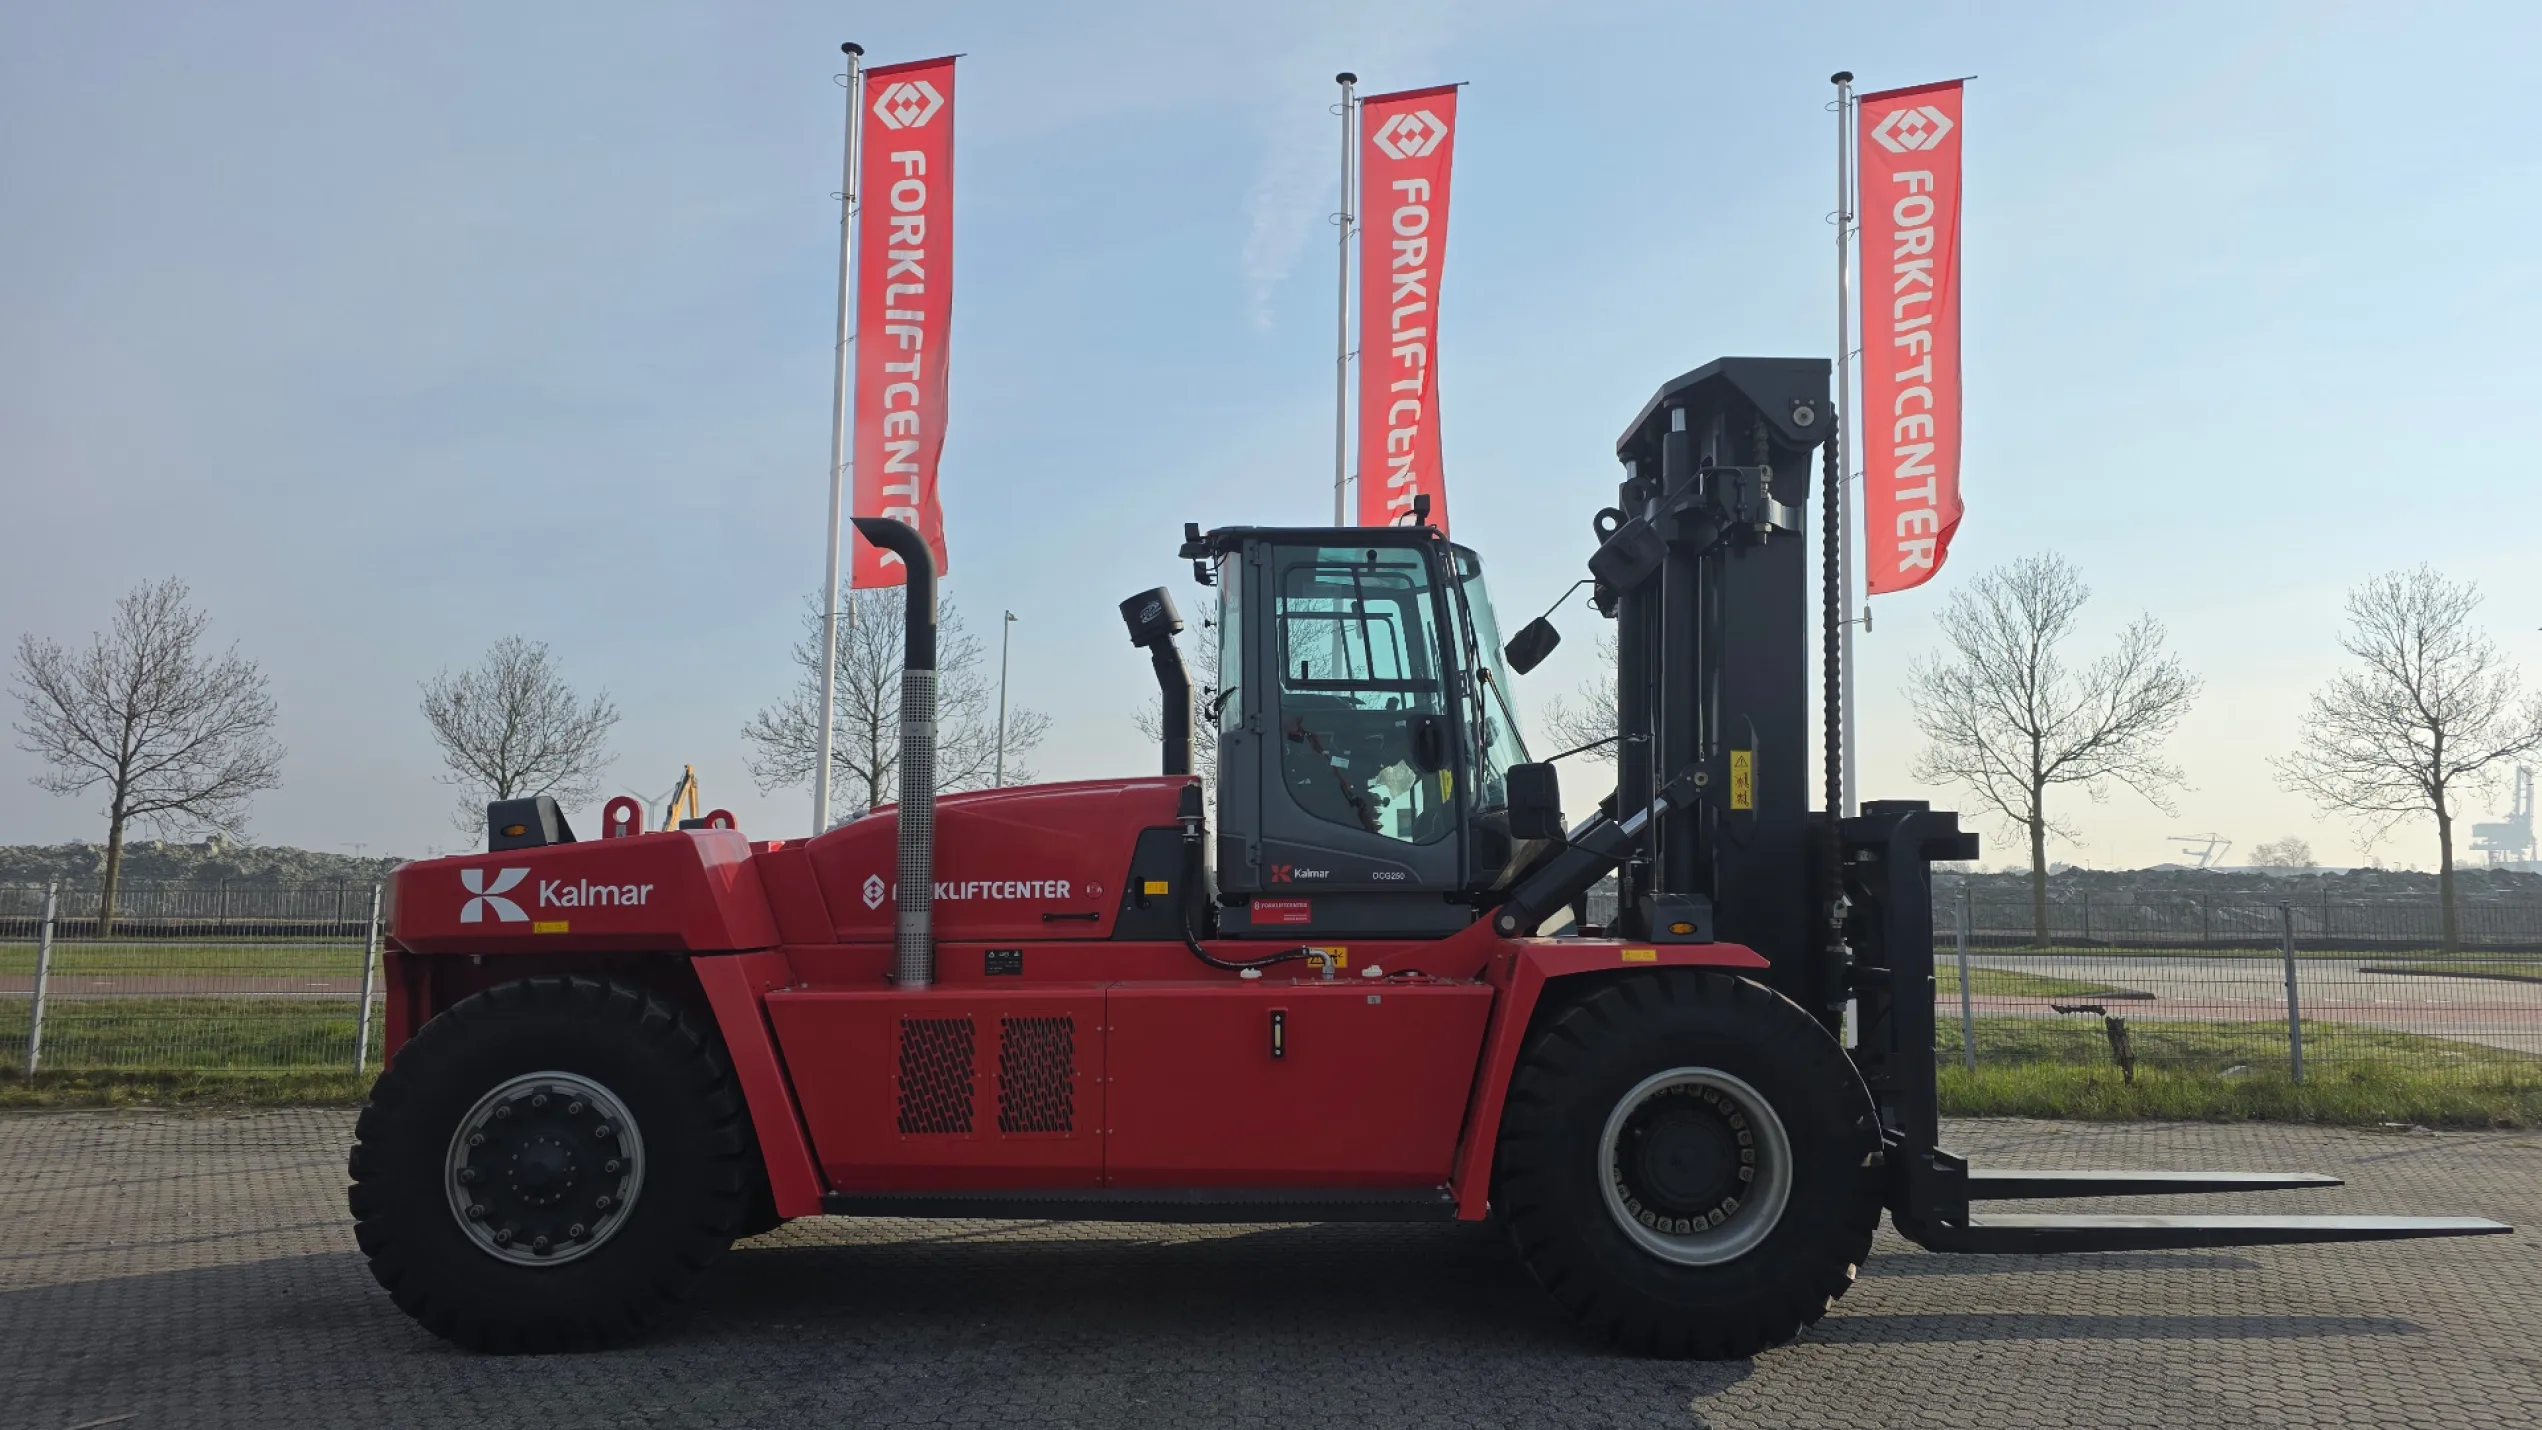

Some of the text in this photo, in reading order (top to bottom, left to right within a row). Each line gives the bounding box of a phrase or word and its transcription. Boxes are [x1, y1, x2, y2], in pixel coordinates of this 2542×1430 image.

[880, 150, 926, 568] FORKLIFTCENTE
[1387, 179, 1430, 528] FORKLIFTCENT
[1892, 170, 1938, 573] FORKLIFTCENTER
[539, 878, 654, 907] Kalmar
[892, 880, 1071, 900] KLIFTCENTER
[1294, 868, 1330, 879] Kalmar
